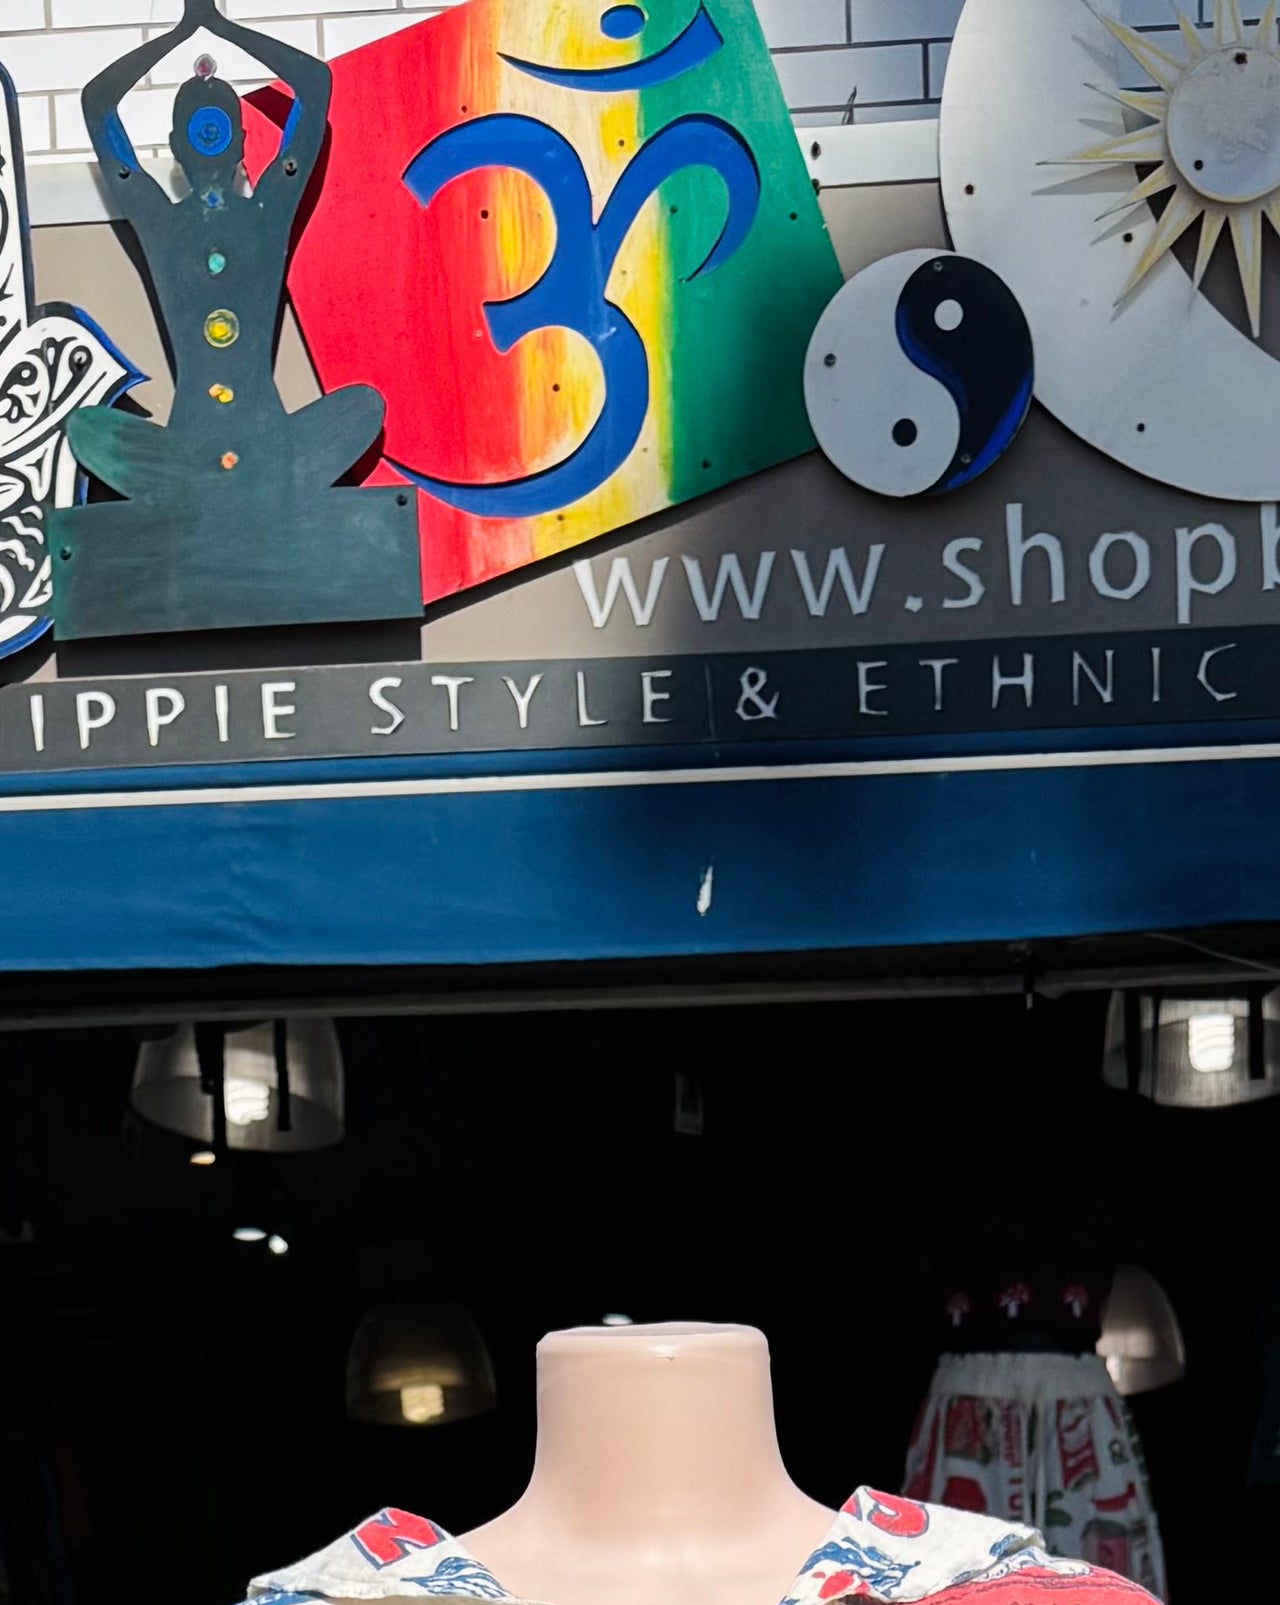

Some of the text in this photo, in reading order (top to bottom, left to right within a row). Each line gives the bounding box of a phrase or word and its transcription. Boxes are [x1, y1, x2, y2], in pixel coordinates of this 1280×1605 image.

[368, 669, 673, 736] STYLE
[736, 664, 780, 722] &
[857, 641, 1240, 716] ETHNIC
